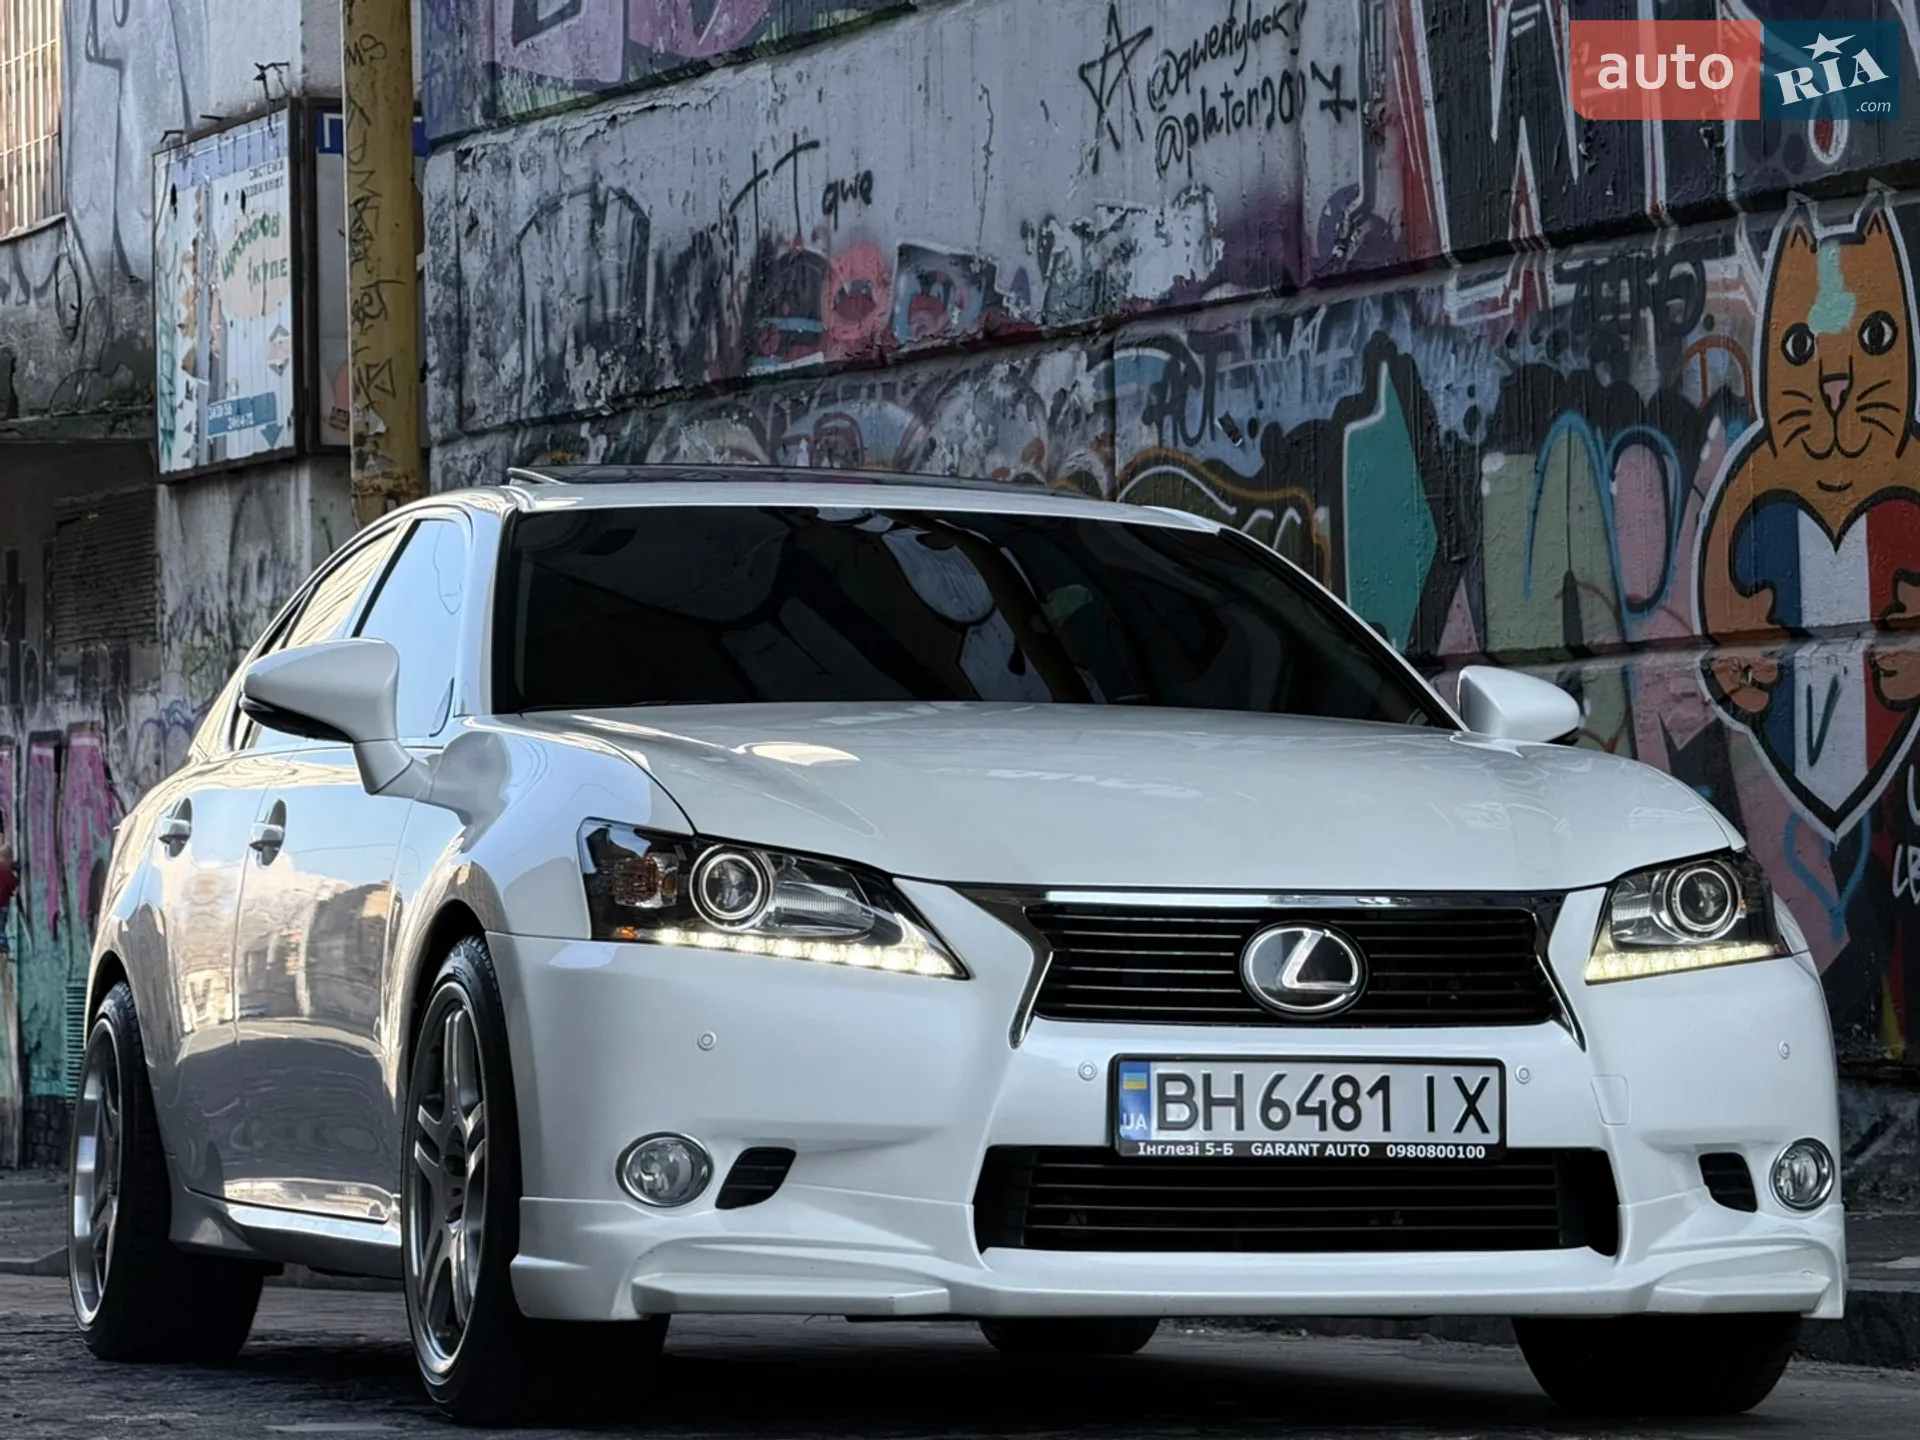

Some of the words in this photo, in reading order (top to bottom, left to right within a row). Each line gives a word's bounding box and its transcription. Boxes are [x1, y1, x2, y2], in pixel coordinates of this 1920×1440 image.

[822, 169, 874, 232] qwe
[1156, 1072, 1245, 1132] BH
[1260, 1073, 1391, 1132] 6481
[1426, 1075, 1491, 1134] IX
[1122, 1112, 1148, 1131] UA
[1138, 1142, 1200, 1156] Інглезі
[1204, 1142, 1234, 1156] 5-Б
[1250, 1142, 1321, 1157] GARANT
[1325, 1143, 1370, 1158] AUTO
[1386, 1144, 1486, 1159] 0980800100
